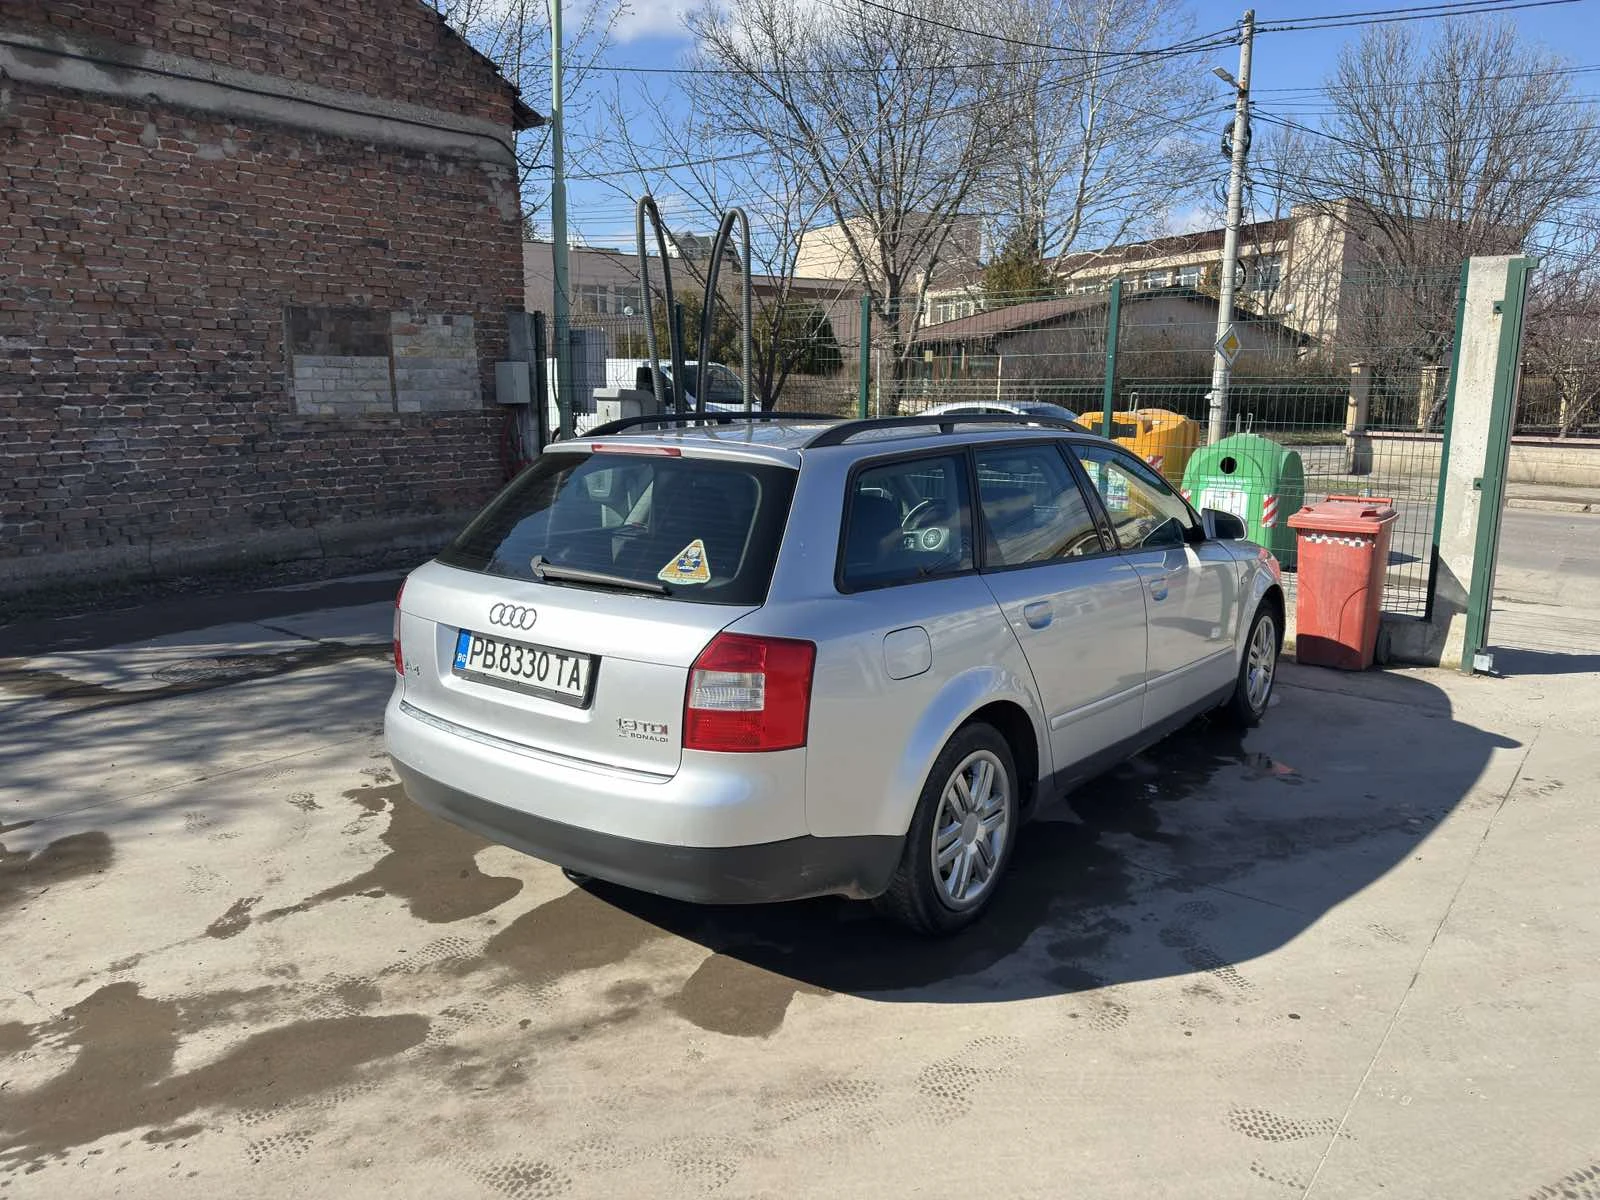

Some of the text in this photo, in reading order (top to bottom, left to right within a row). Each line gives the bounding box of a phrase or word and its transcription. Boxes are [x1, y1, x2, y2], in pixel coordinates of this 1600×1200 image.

[457, 652, 467, 663] BG
[499, 643, 550, 682] 8330
[555, 654, 580, 690] TA
[638, 722, 668, 736] TDI
